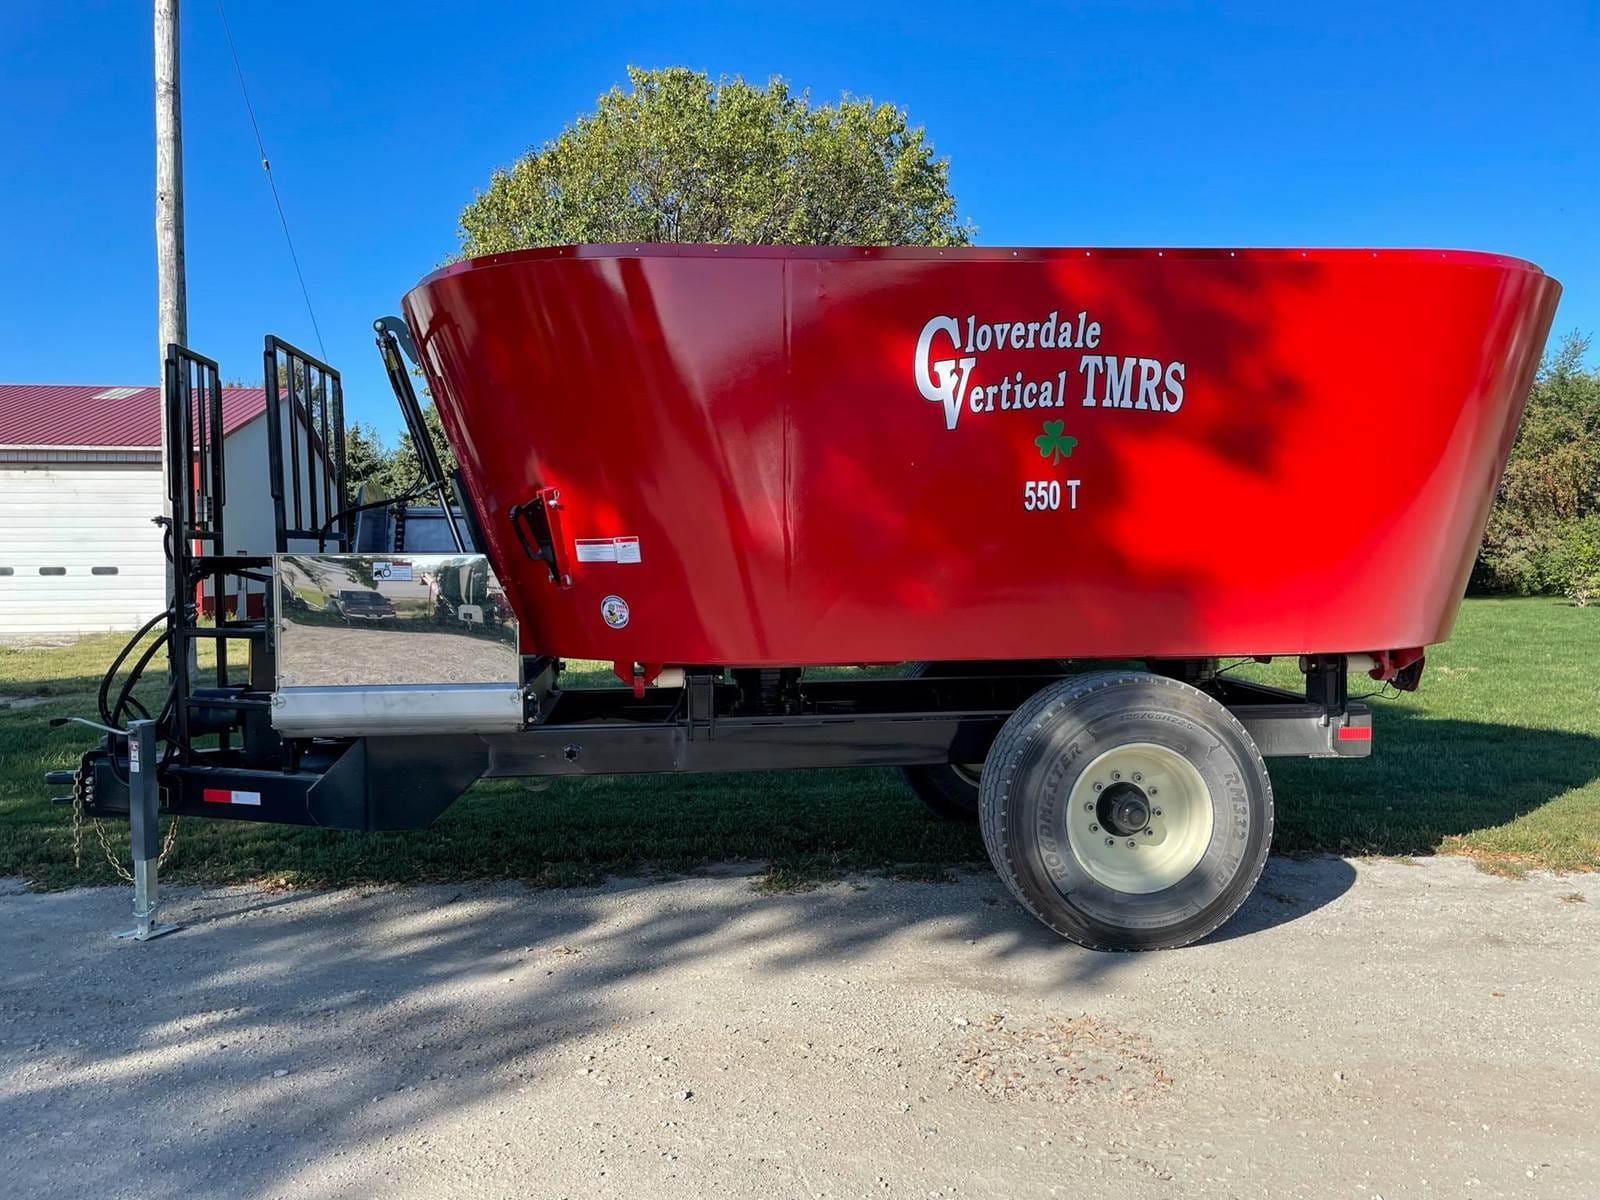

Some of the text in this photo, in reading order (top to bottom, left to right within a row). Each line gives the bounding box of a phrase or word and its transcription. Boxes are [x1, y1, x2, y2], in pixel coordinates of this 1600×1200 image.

[914, 311, 1102, 402] Cloverdale
[934, 355, 1186, 430] Vertical TMRS
[1023, 479, 1081, 511] 550 T
[1037, 741, 1083, 881] ROADMASTER
[1223, 771, 1248, 841] RM332
